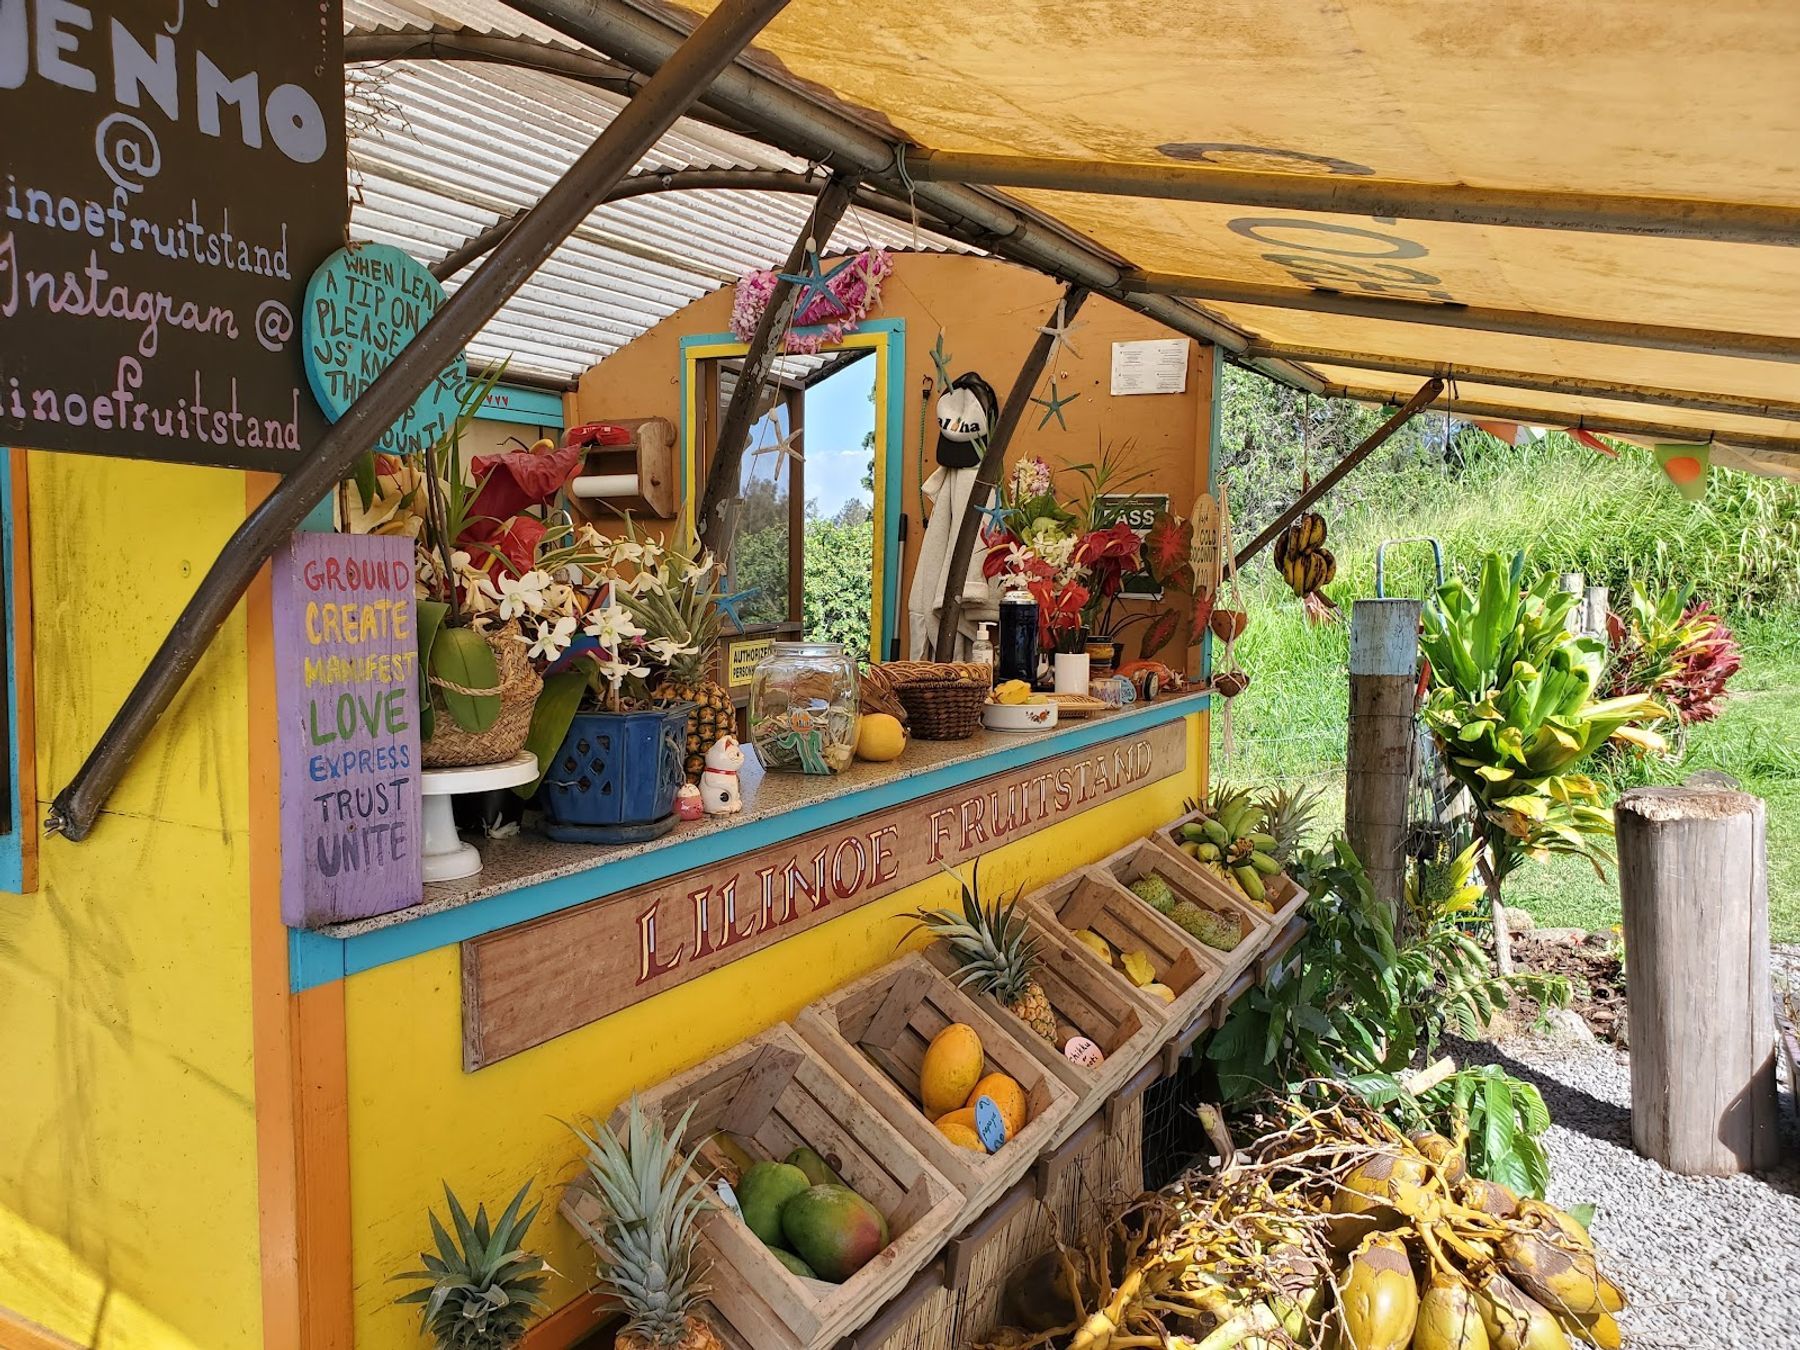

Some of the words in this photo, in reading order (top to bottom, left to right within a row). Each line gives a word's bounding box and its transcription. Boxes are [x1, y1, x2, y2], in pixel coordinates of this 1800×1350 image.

[0, 231, 239, 358] Instagram
[343, 255, 394, 288] WHEN
[325, 269, 338, 294] A
[345, 275, 386, 317] TIP
[391, 297, 420, 335] ON
[314, 338, 348, 367] US
[315, 298, 402, 358] PLEASE
[0, 356, 301, 451] inoefruitstand
[304, 557, 410, 592] GROUND
[305, 599, 410, 645] CREATE
[304, 652, 417, 688] MANIFEST
[310, 689, 409, 746] LOVE
[309, 745, 410, 782] EXPRESS
[313, 778, 409, 823] TRUST
[317, 822, 407, 877] UNITE
[635, 823, 899, 987] LILINOE
[927, 740, 1152, 864] FRUITSTAND
